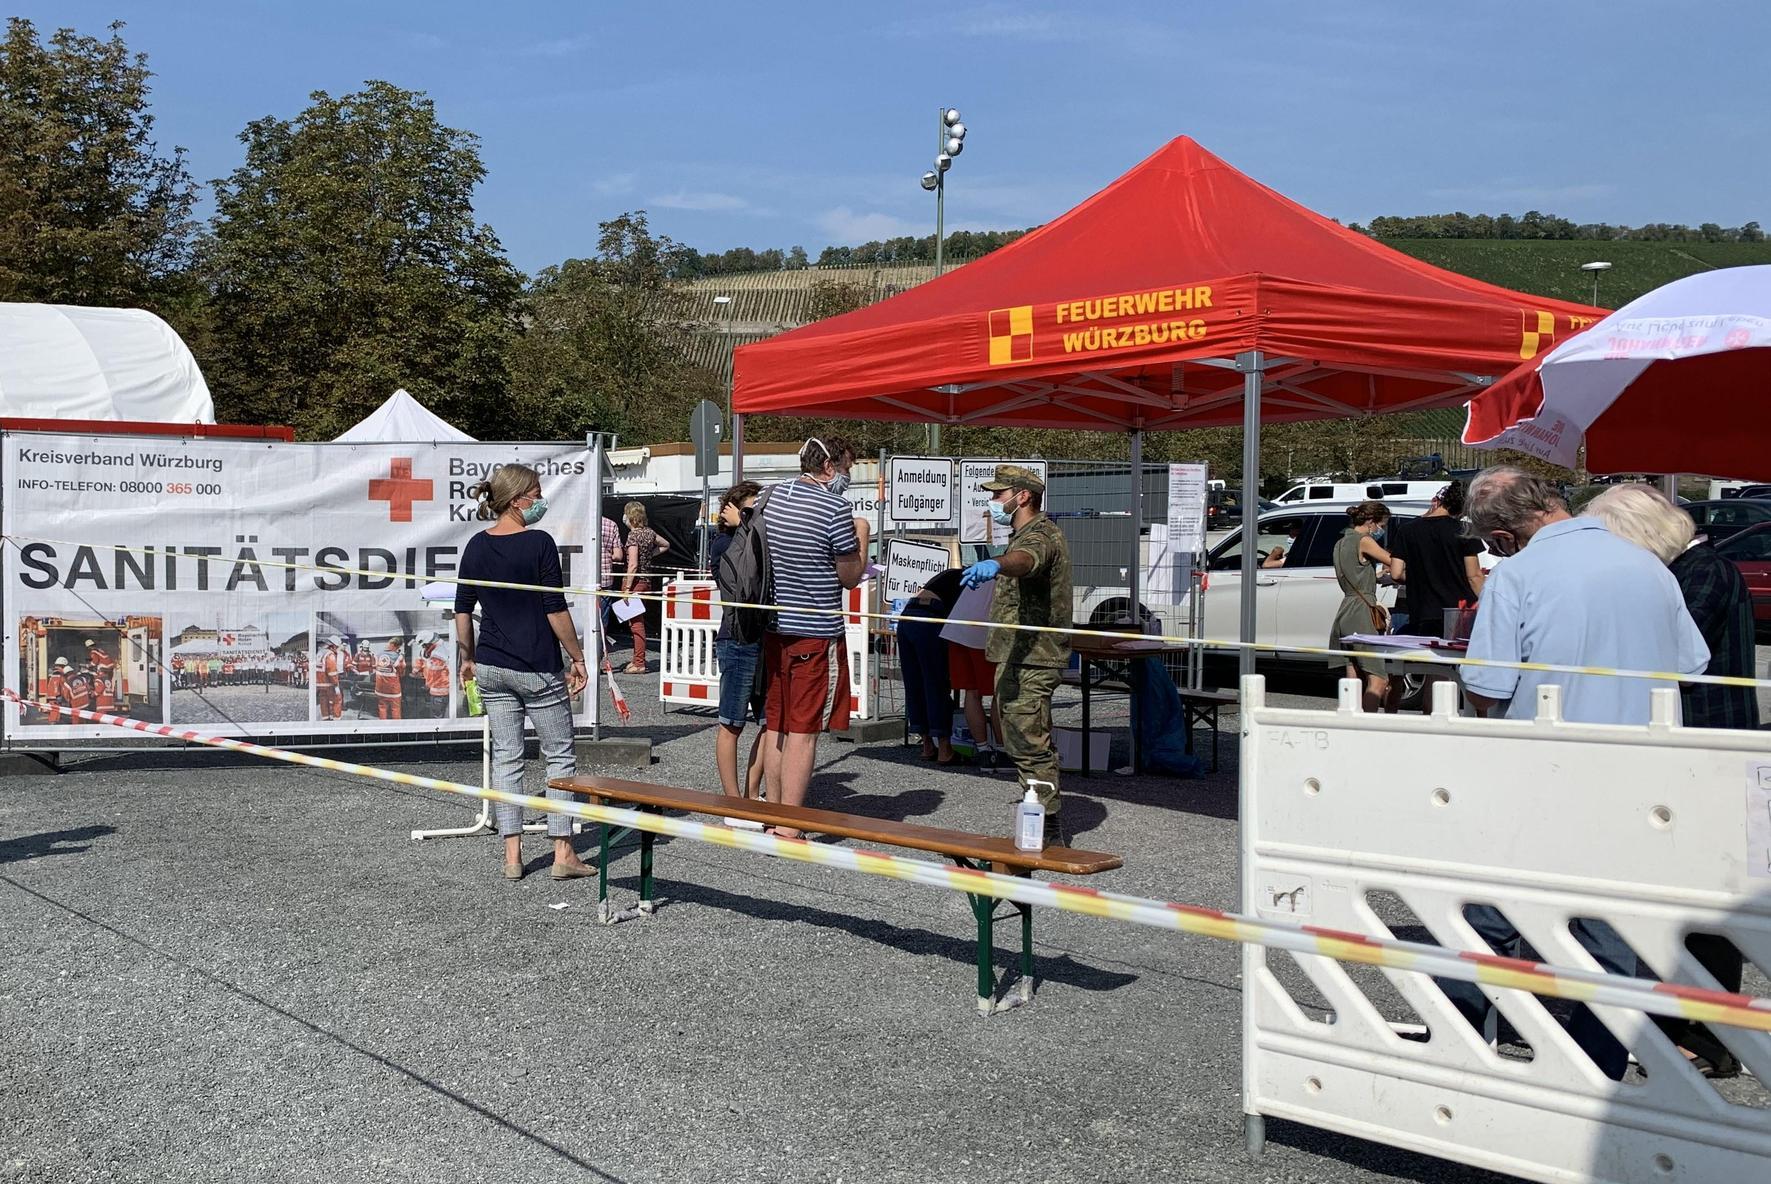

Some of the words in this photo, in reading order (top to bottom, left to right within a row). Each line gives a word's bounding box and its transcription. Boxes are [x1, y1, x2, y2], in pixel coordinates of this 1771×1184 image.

[1056, 286, 1213, 324] FEUERWEHR
[1063, 319, 1208, 353] WÜRZBURG
[19, 448, 134, 467] Kreisverband
[140, 453, 223, 473] Würzburg
[897, 468, 947, 488] Anmeldung
[965, 465, 995, 479] Folgende
[18, 478, 116, 493] INFO-TELEFON:
[119, 481, 163, 494] 08000
[166, 483, 192, 495] 365
[195, 484, 222, 496] 000
[898, 494, 945, 513] Fußgänger
[19, 535, 584, 592] SANITÄTSDIET
[891, 552, 946, 573] Maskenpflicht
[888, 577, 901, 591] für
